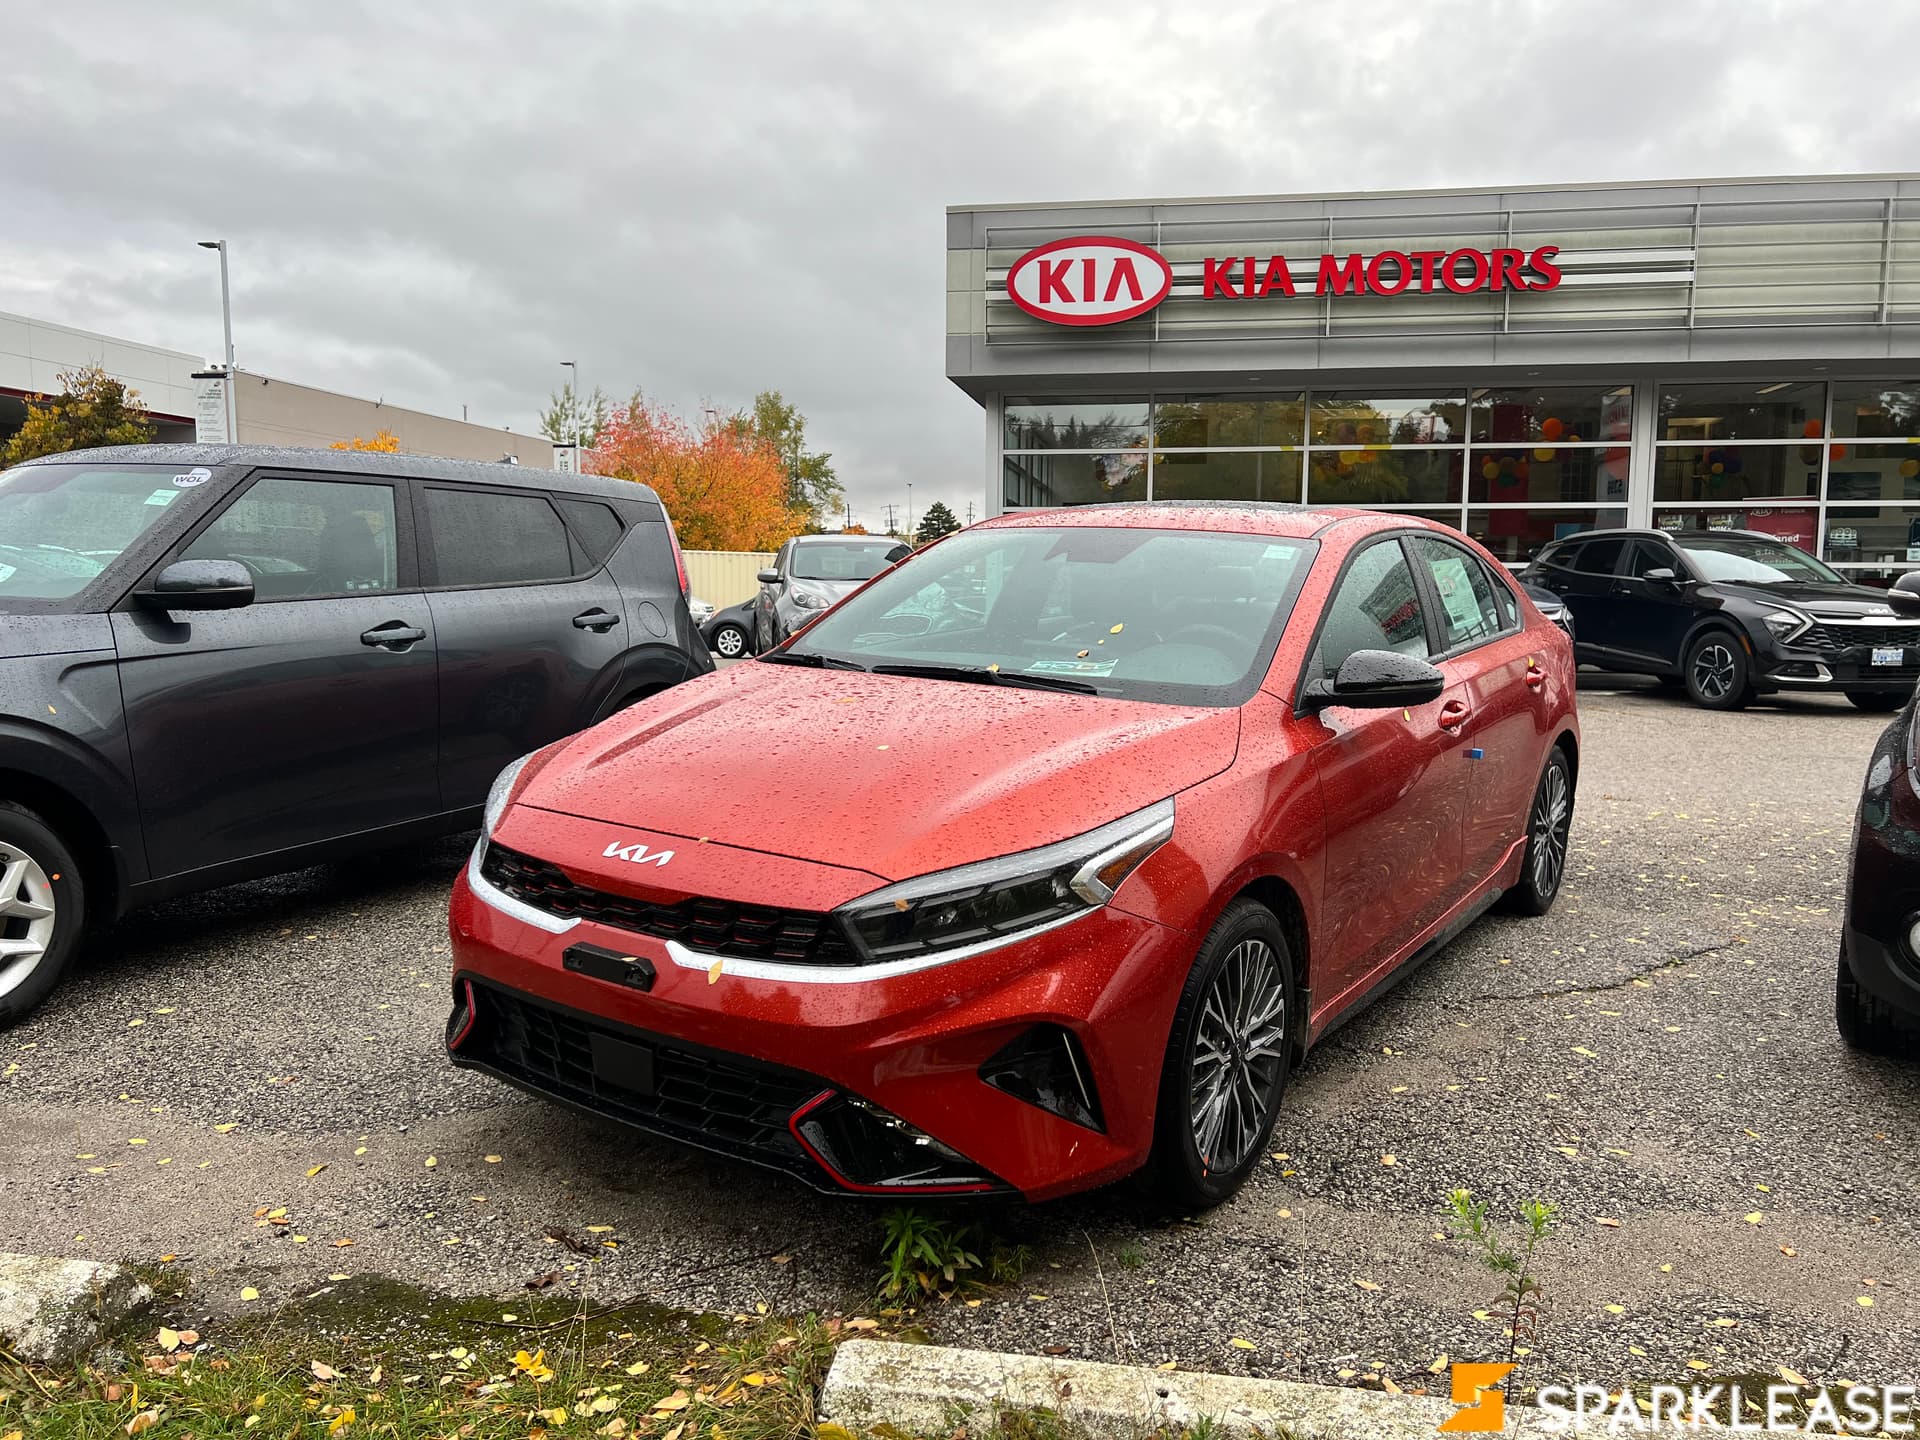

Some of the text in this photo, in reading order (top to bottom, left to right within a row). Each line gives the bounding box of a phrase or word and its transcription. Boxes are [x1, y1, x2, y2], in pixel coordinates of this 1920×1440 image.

[1037, 257, 1146, 304] KIA
[1203, 245, 1563, 299] KIA MOTORS
[602, 840, 675, 868] KIA
